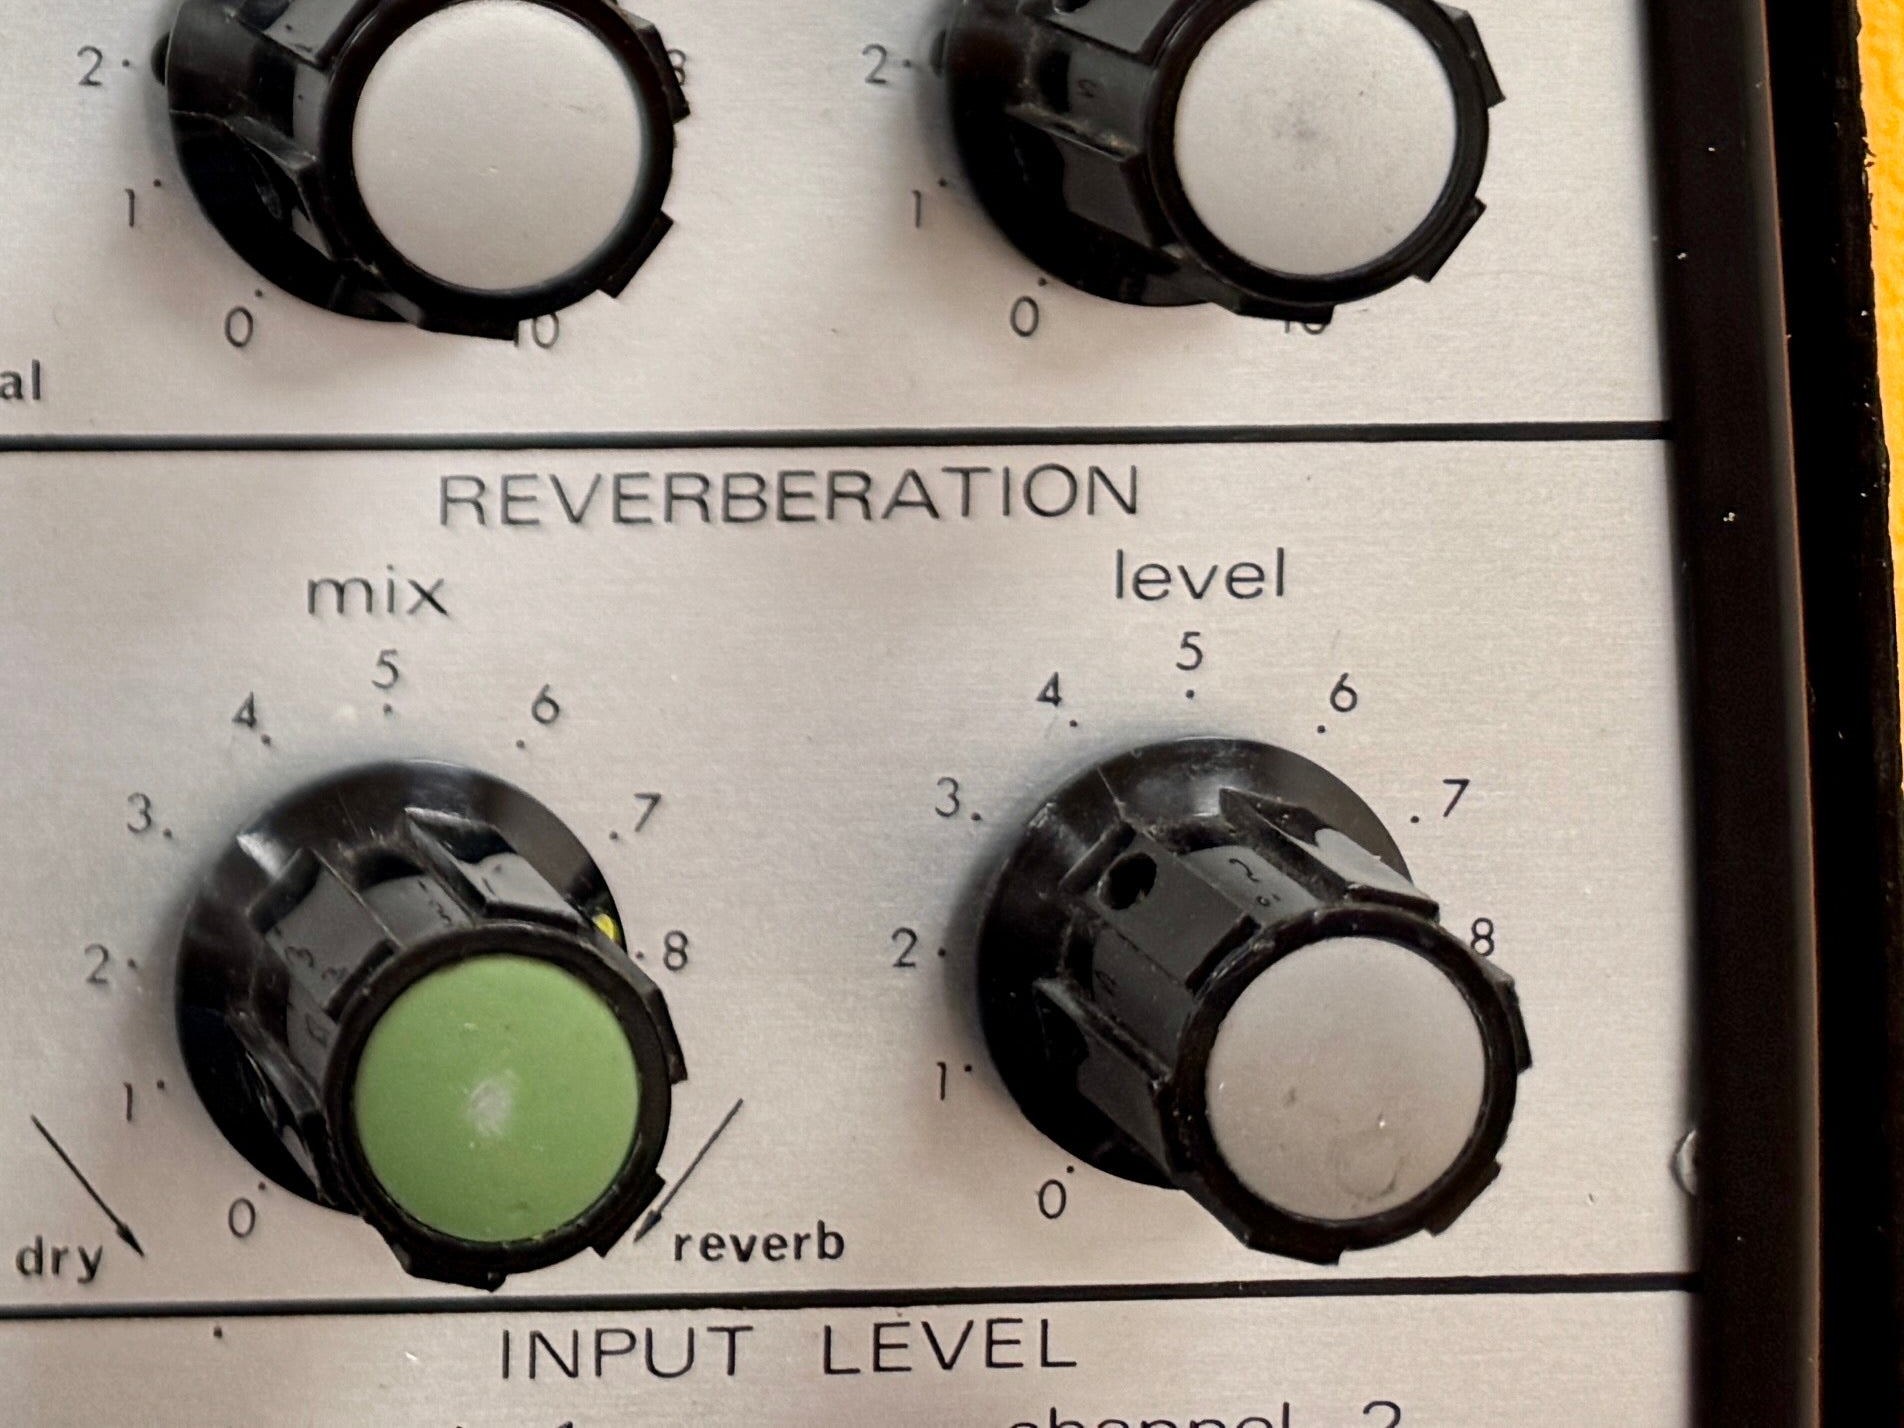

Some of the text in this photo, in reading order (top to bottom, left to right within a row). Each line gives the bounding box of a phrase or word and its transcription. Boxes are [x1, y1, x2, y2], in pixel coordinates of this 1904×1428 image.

[77, 45, 104, 88] 2
[440, 463, 1139, 530] REVERBERATION
[308, 564, 452, 619] mix
[1115, 547, 1286, 602] level
[1035, 672, 1065, 708] 4
[127, 792, 156, 836] 3
[634, 792, 663, 833] 7
[1442, 778, 1472, 818] 7
[891, 927, 918, 972] 2
[15, 1235, 103, 1287] dry
[674, 1219, 845, 1265] reverb
[502, 1317, 1078, 1382] INPUT LEVEL
